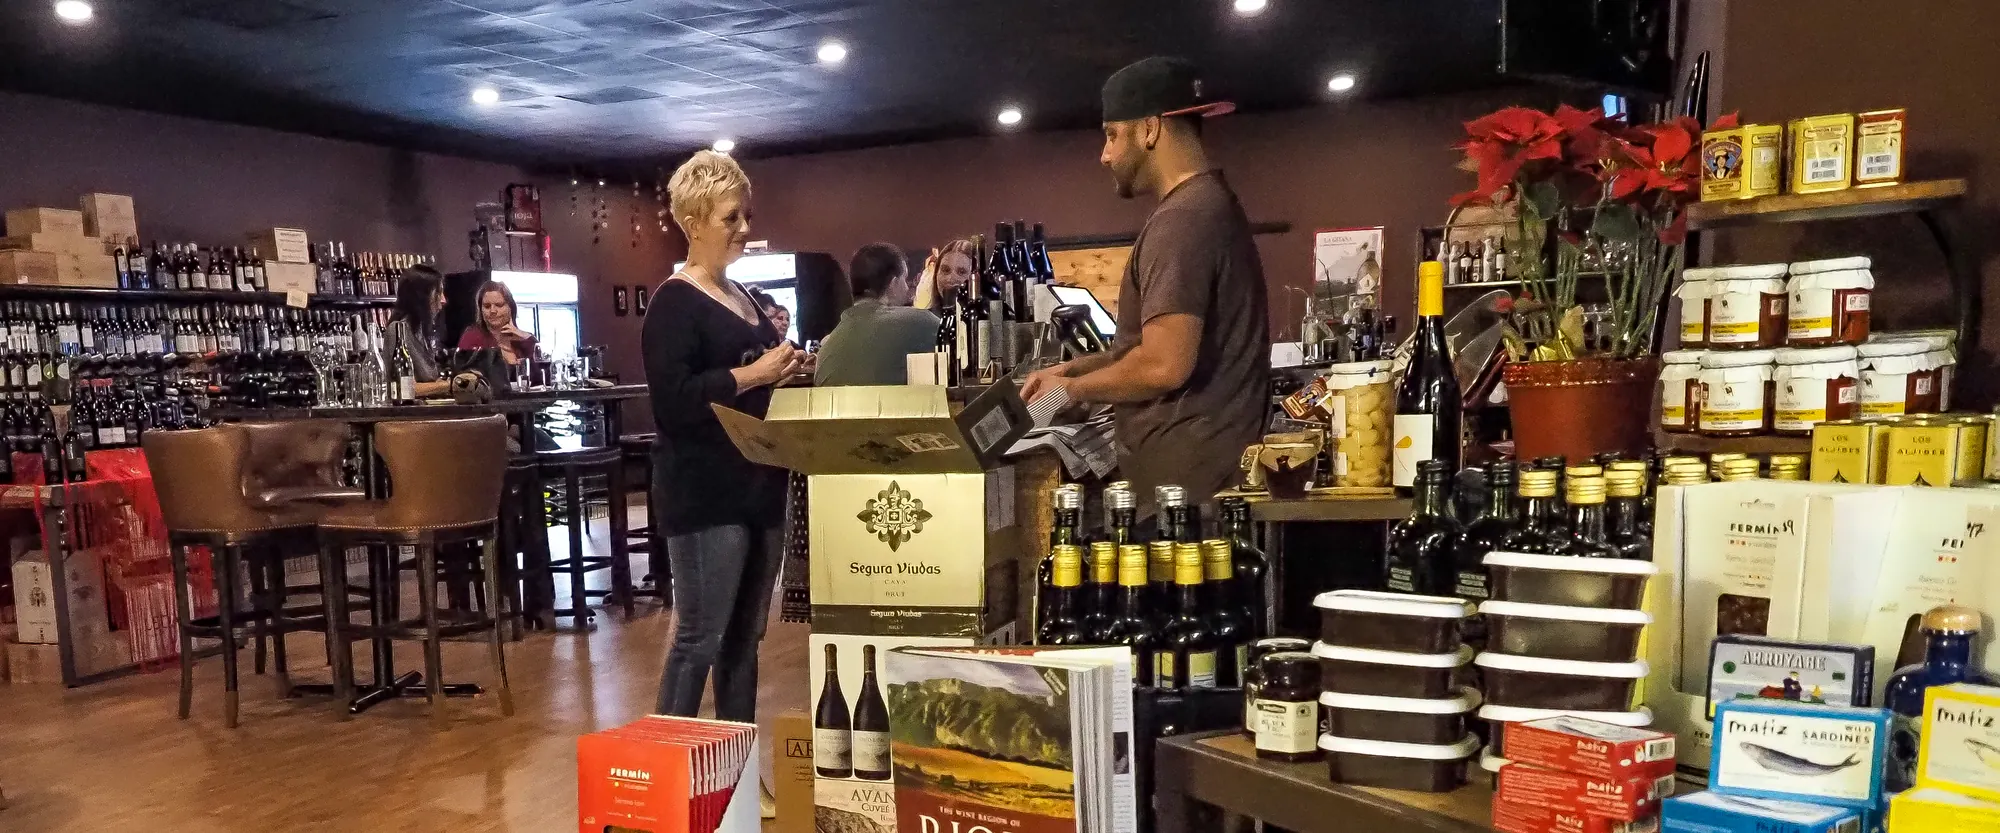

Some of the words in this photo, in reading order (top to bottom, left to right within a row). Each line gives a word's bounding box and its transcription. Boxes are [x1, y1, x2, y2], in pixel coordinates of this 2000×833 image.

[850, 562, 892, 577] Segura
[897, 562, 941, 575] Viudas
[1844, 724, 1872, 733] WILD
[1802, 730, 1870, 746] SARDINES
